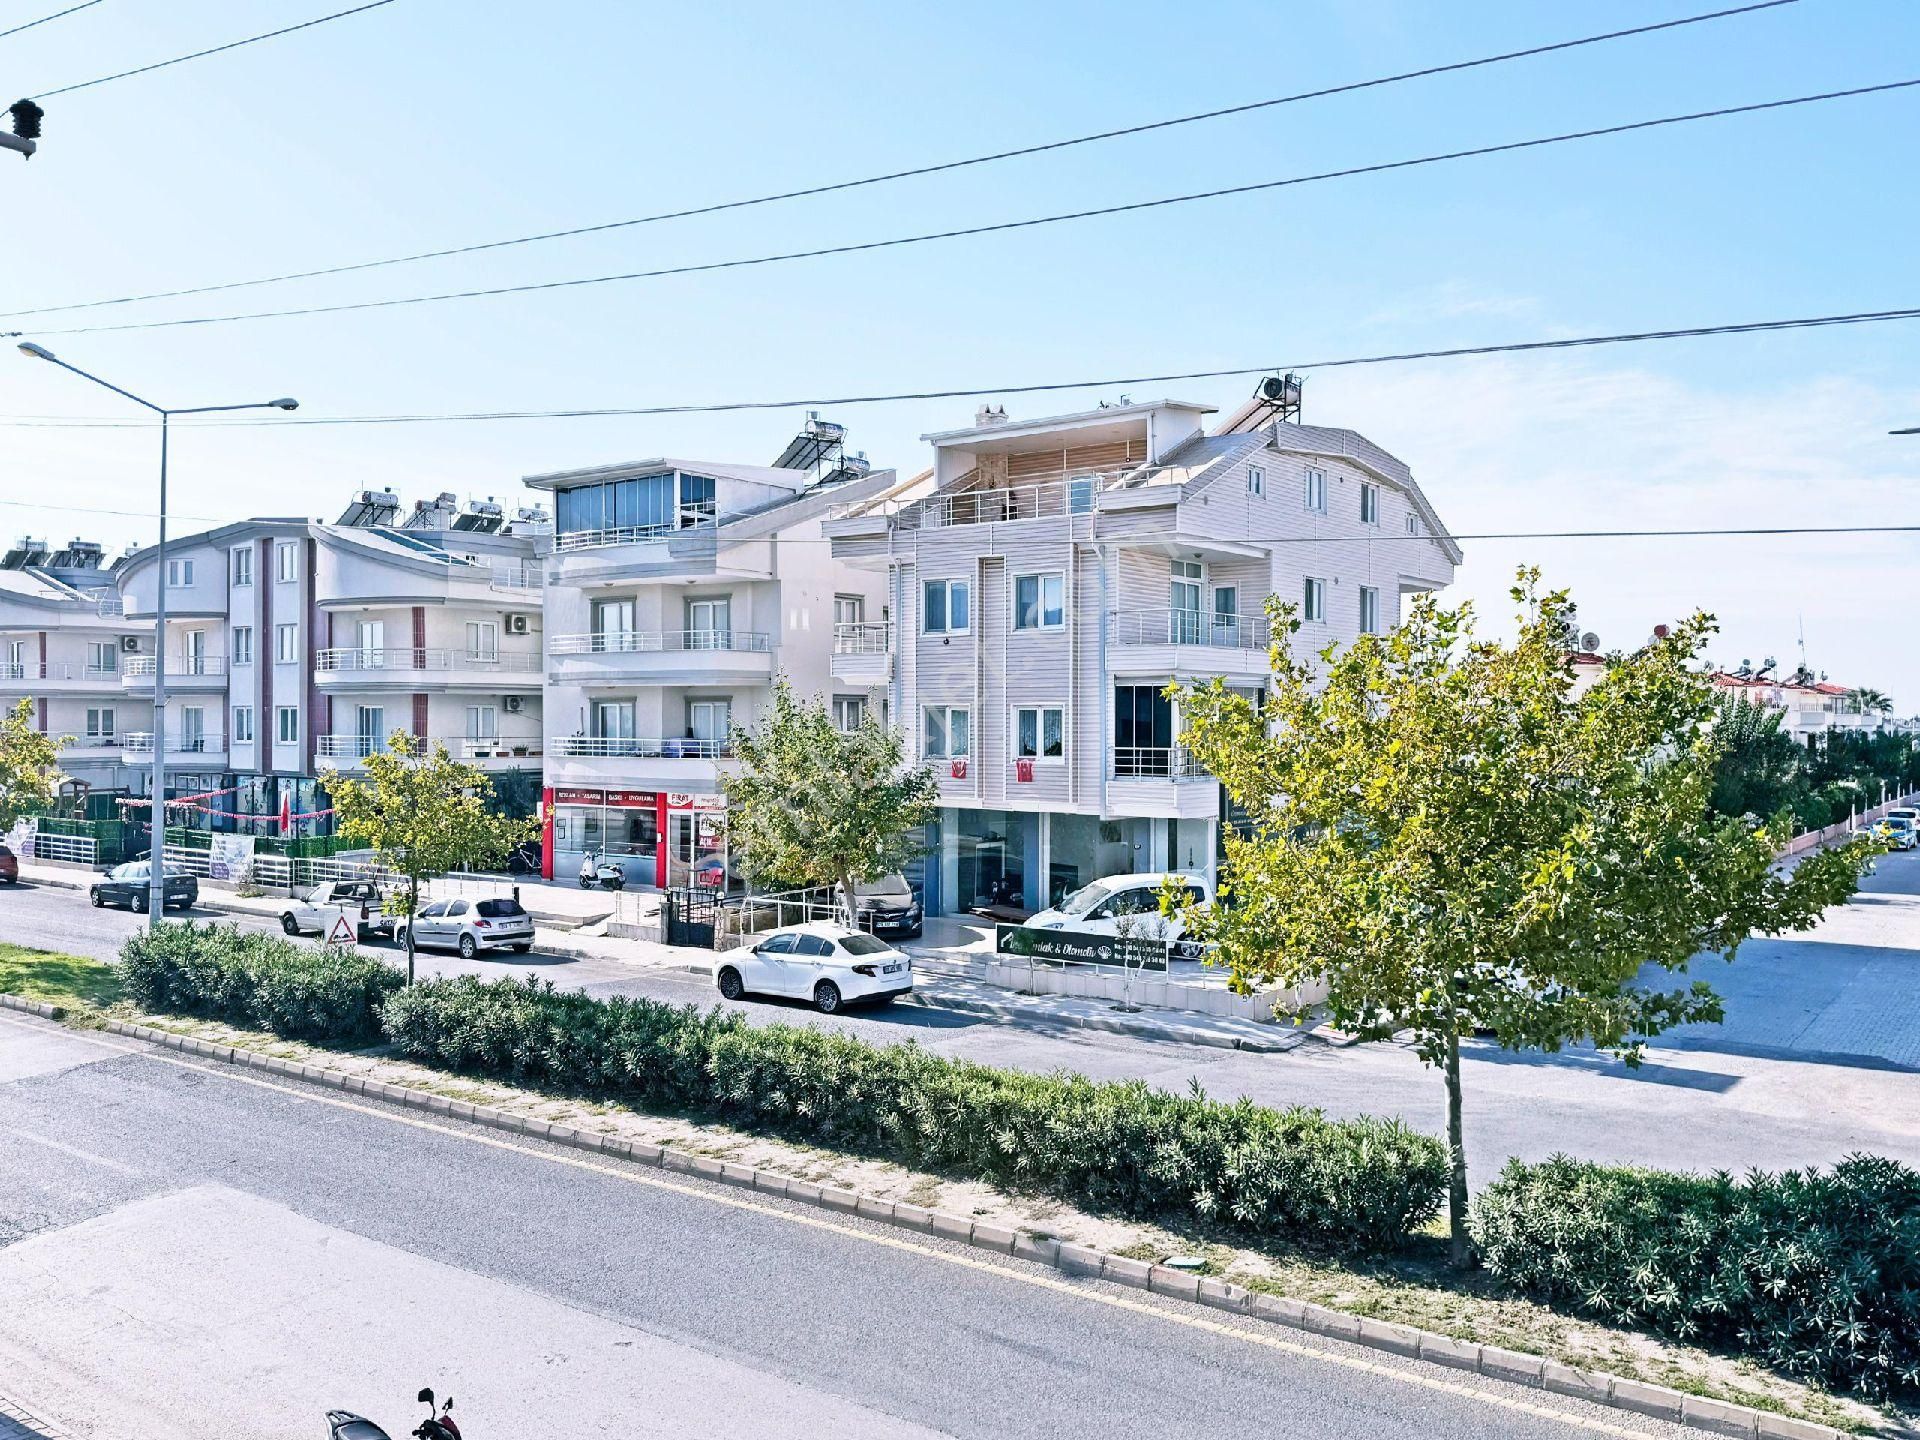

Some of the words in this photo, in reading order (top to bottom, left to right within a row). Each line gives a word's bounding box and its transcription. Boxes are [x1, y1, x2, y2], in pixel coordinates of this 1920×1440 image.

[671, 793, 689, 801] FIRAT
[699, 837, 713, 848] AÇIK
[1054, 945, 1061, 954] &
